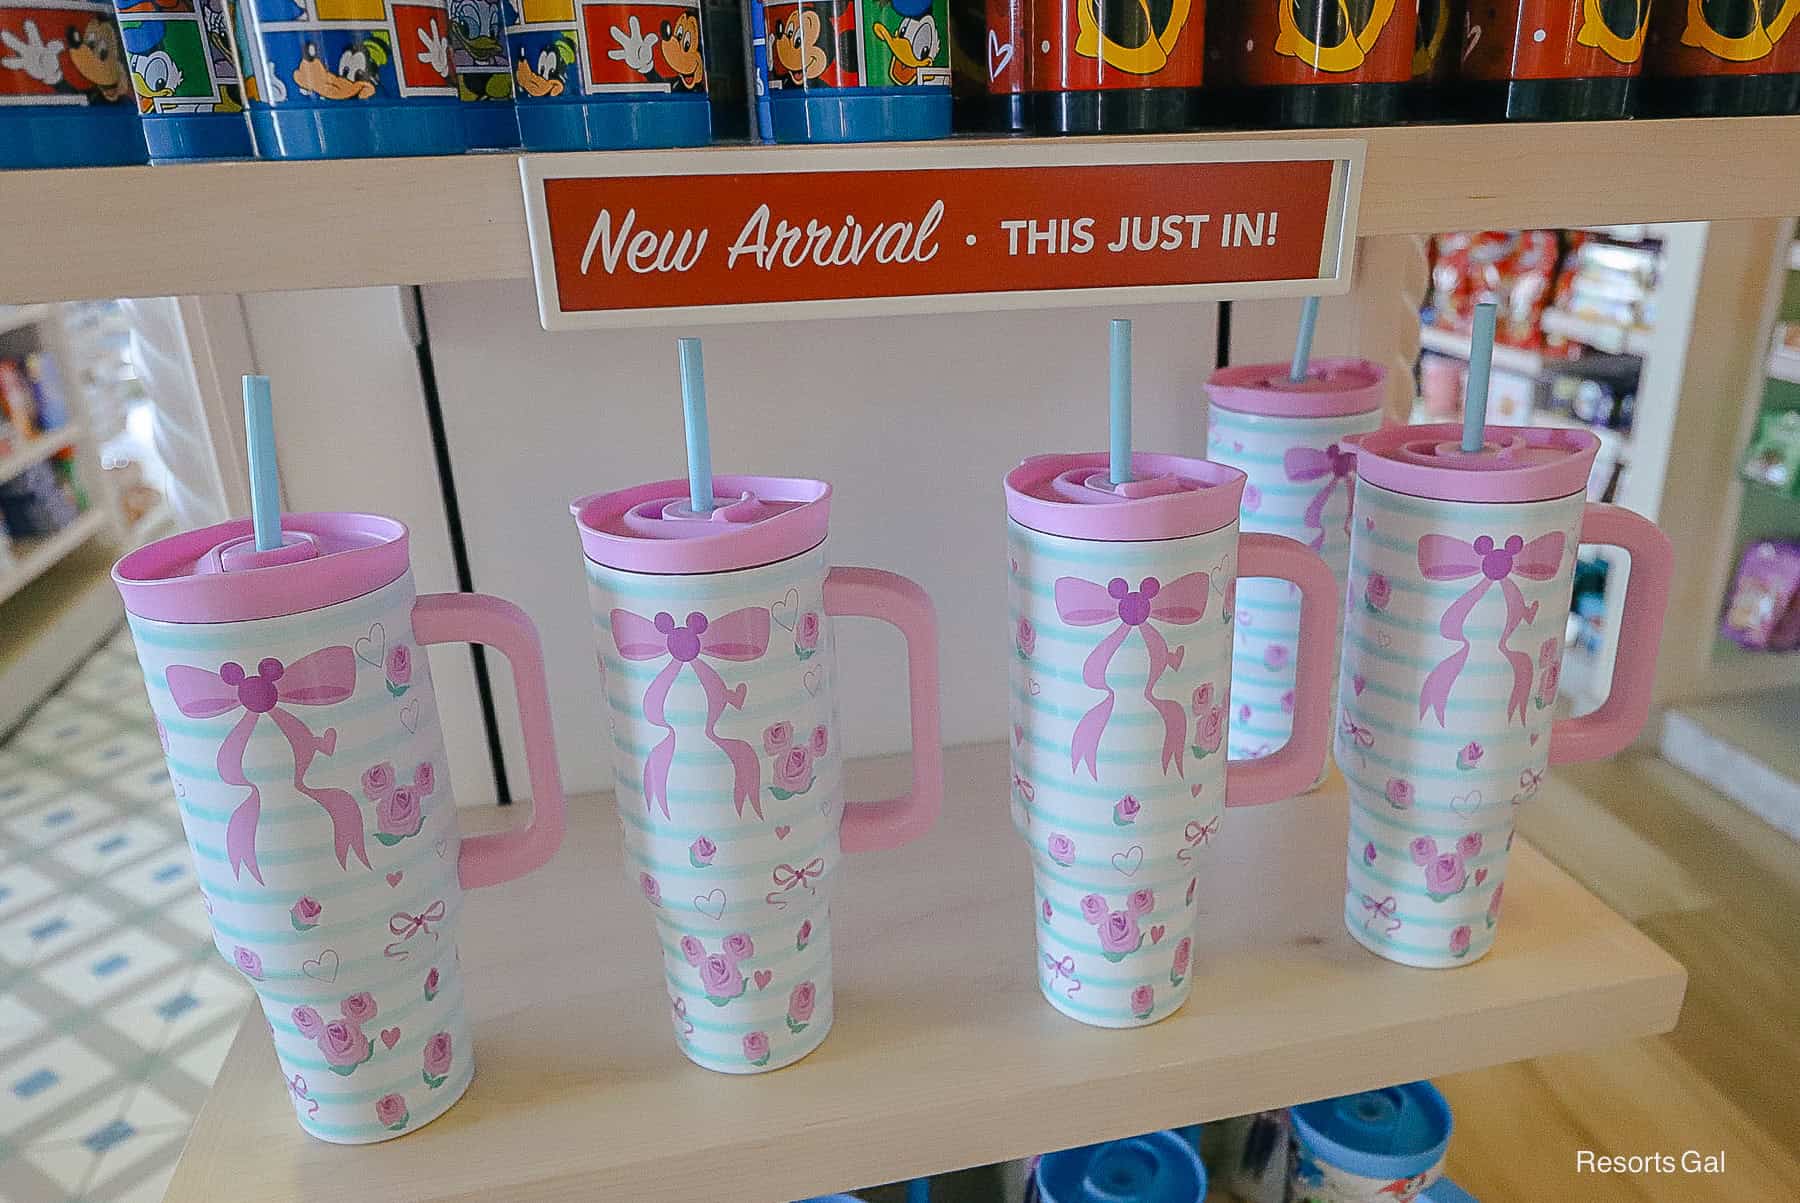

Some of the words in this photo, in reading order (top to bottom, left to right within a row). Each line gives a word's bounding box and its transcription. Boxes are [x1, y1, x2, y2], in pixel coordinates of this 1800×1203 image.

[580, 207, 709, 275] New
[727, 199, 945, 271] Arrival
[1000, 217, 1095, 256] THIS
[1107, 213, 1211, 252] JUST
[1221, 211, 1279, 248] IN!
